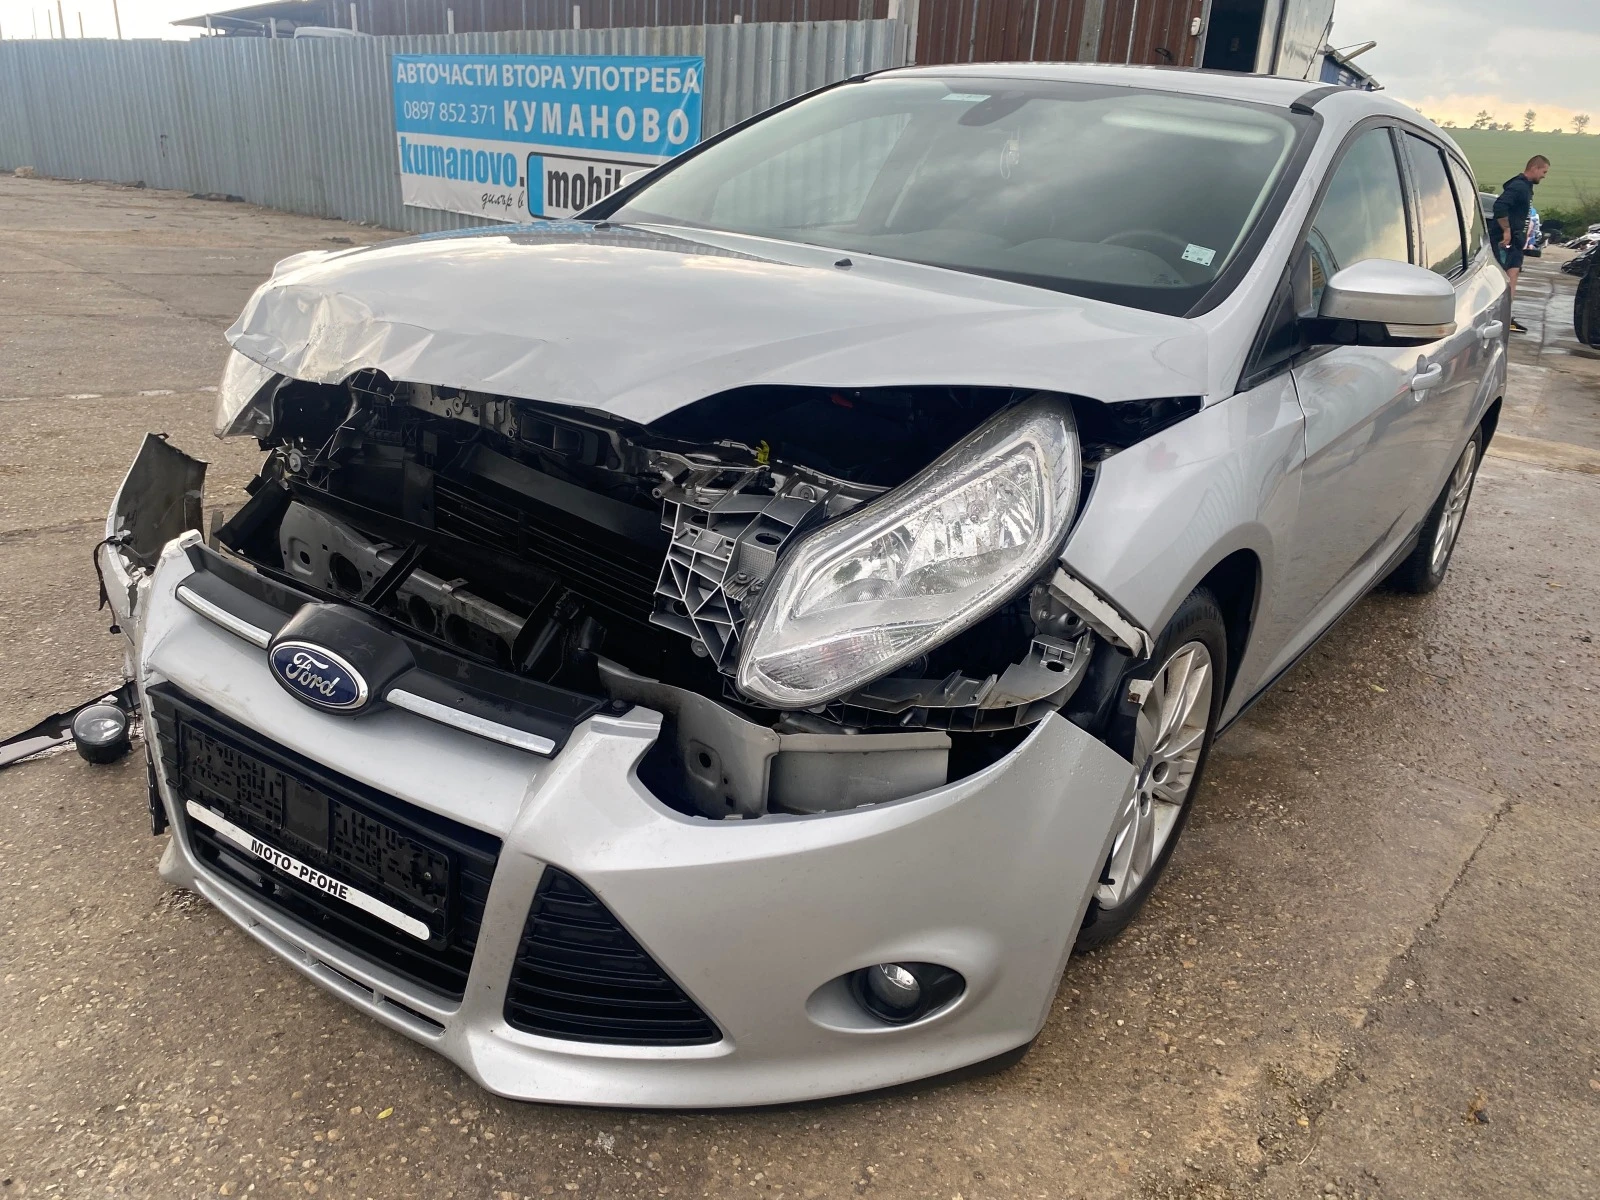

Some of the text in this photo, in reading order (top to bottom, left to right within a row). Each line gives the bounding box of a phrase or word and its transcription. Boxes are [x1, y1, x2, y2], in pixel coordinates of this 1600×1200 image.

[396, 63, 701, 94] АВТОЧАСТИ ВТОРА УПОТРЕБА
[404, 100, 496, 125] 0897 852 371
[503, 100, 690, 145] КУМАНОВО
[285, 652, 341, 697] Ford
